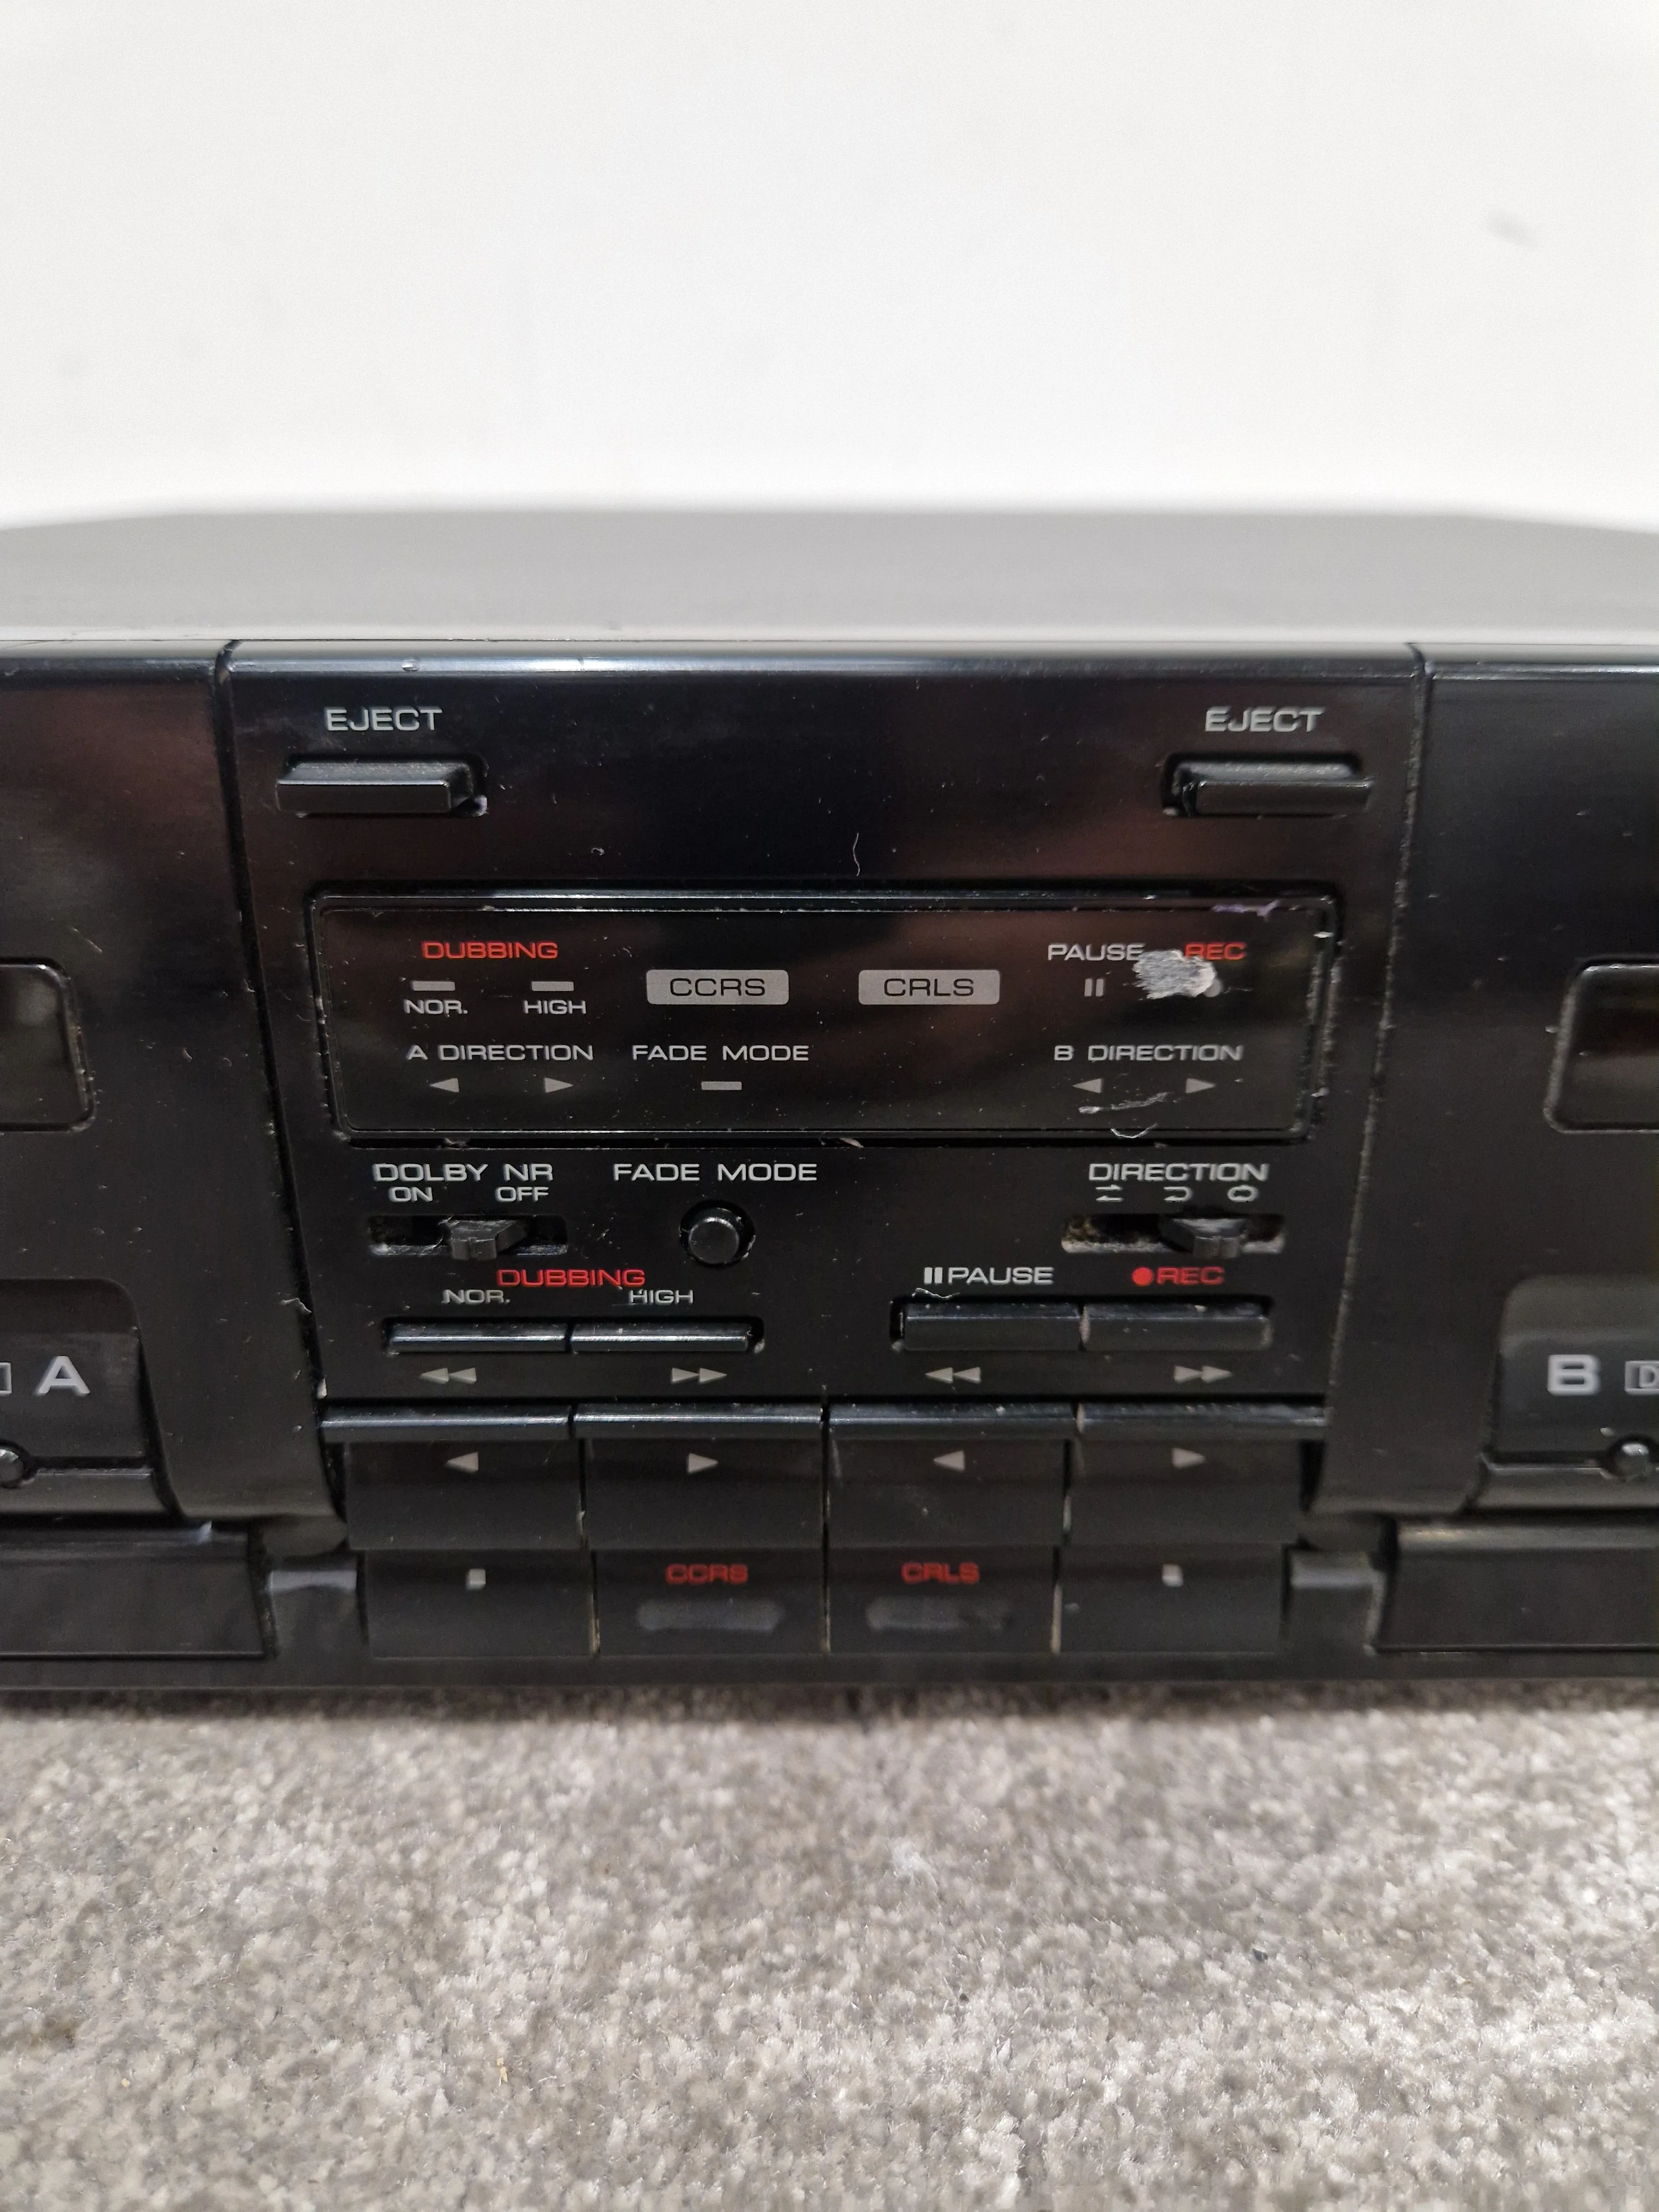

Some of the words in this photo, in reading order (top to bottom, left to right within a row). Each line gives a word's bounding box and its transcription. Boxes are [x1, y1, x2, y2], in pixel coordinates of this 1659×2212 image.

[326, 708, 442, 731] EJECT
[1206, 708, 1323, 732] EJECT
[422, 942, 557, 959] DUBBING
[1047, 943, 1145, 961] PAUSE
[1185, 943, 1244, 960] REC
[670, 978, 765, 996] CCRS
[884, 978, 973, 996] CRLS
[404, 1000, 467, 1014] NOR.
[524, 1000, 586, 1014] HIGH
[406, 1045, 428, 1060] A
[439, 1045, 593, 1060] DIRECTION
[633, 1045, 707, 1060] FADE
[723, 1045, 808, 1061] MODE
[1055, 1046, 1074, 1060] B
[1088, 1045, 1242, 1062] DIRECTION
[373, 1164, 488, 1181] DOLBY
[504, 1164, 553, 1181] NR
[614, 1164, 700, 1181] FADE
[718, 1164, 817, 1181] MODE
[1089, 1163, 1267, 1181] DIRECTION
[390, 1187, 432, 1202] ON
[497, 1187, 549, 1201] OFF
[498, 1269, 645, 1286] DUBBING
[948, 1267, 1053, 1284] PAUSE
[1157, 1267, 1222, 1284] REC
[442, 1290, 510, 1303] NOR.
[630, 1289, 693, 1303] HIGH
[36, 1356, 90, 1395] A
[1548, 1354, 1598, 1394] B
[666, 1564, 747, 1583] CCRS
[901, 1563, 978, 1583] CRLS
